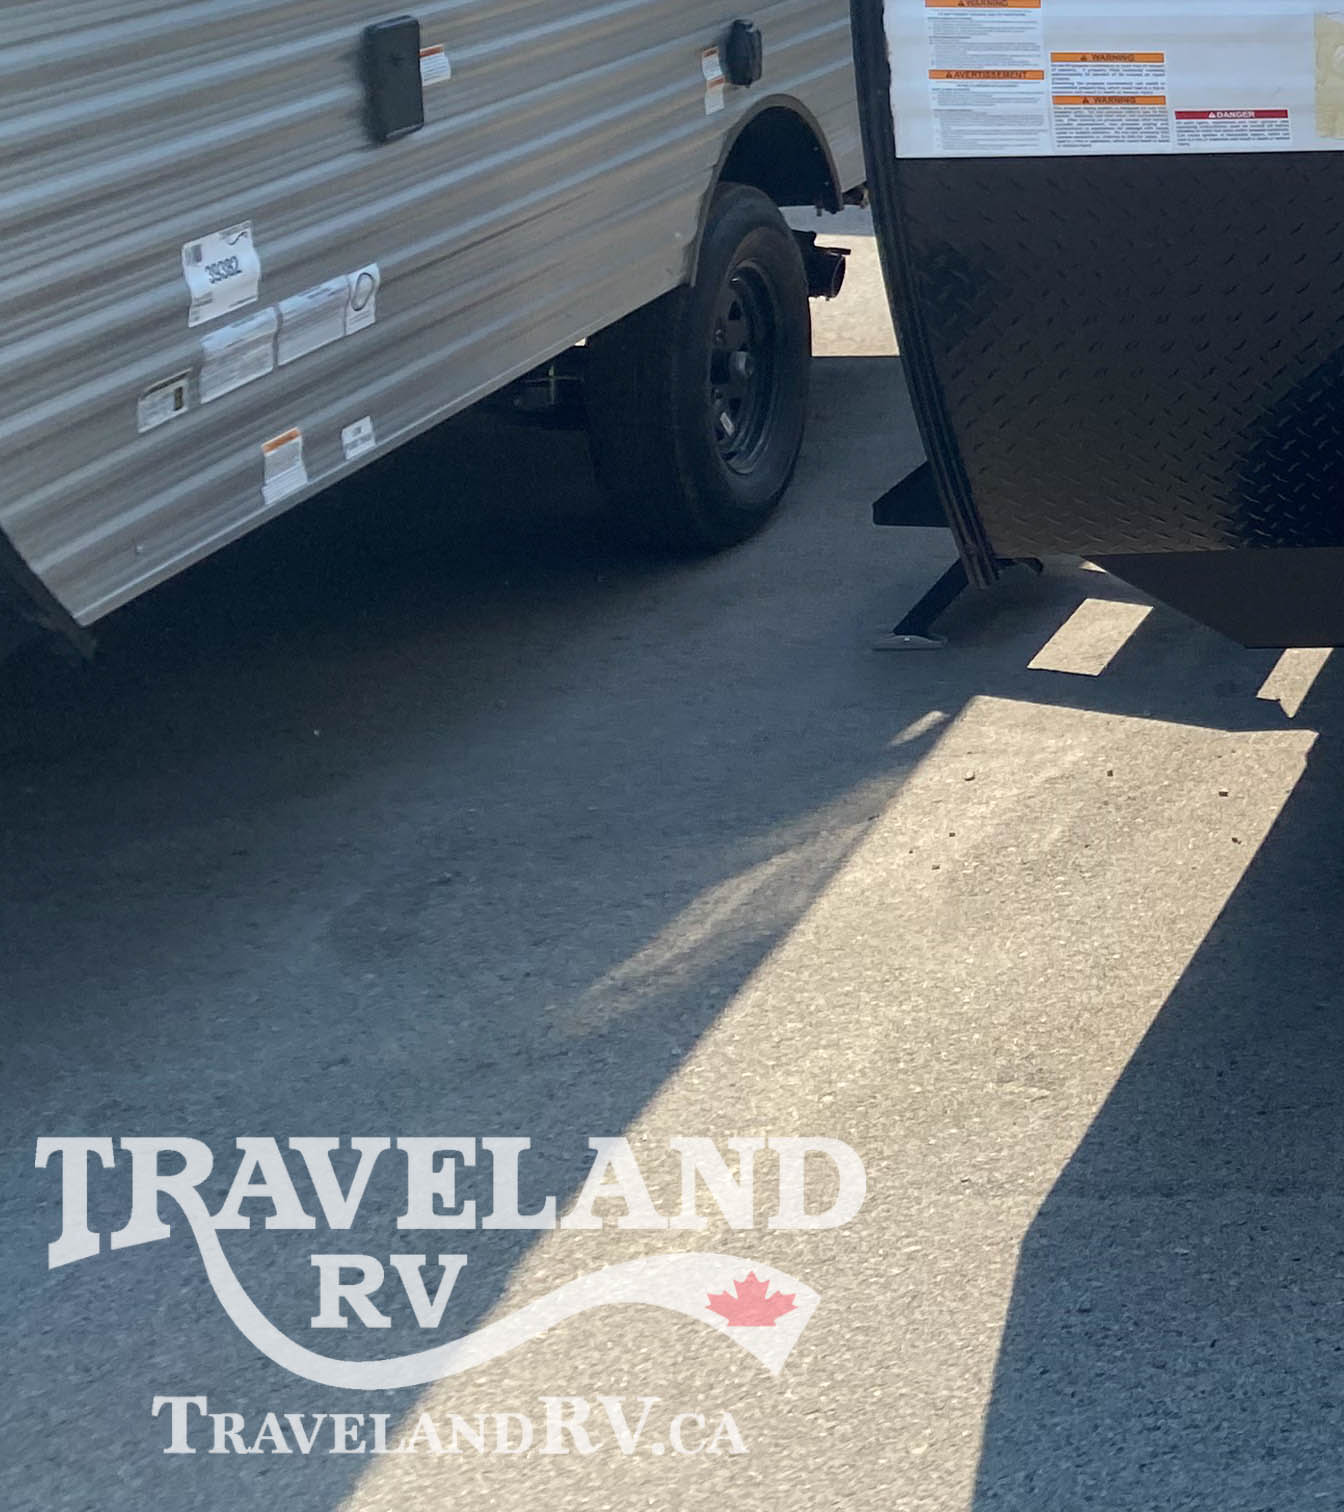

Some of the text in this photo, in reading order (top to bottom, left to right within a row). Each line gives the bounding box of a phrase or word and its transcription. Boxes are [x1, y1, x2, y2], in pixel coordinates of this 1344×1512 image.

[1091, 53, 1136, 62] WARNING
[1093, 95, 1137, 104] WARNING
[1215, 110, 1256, 119] DANGER
